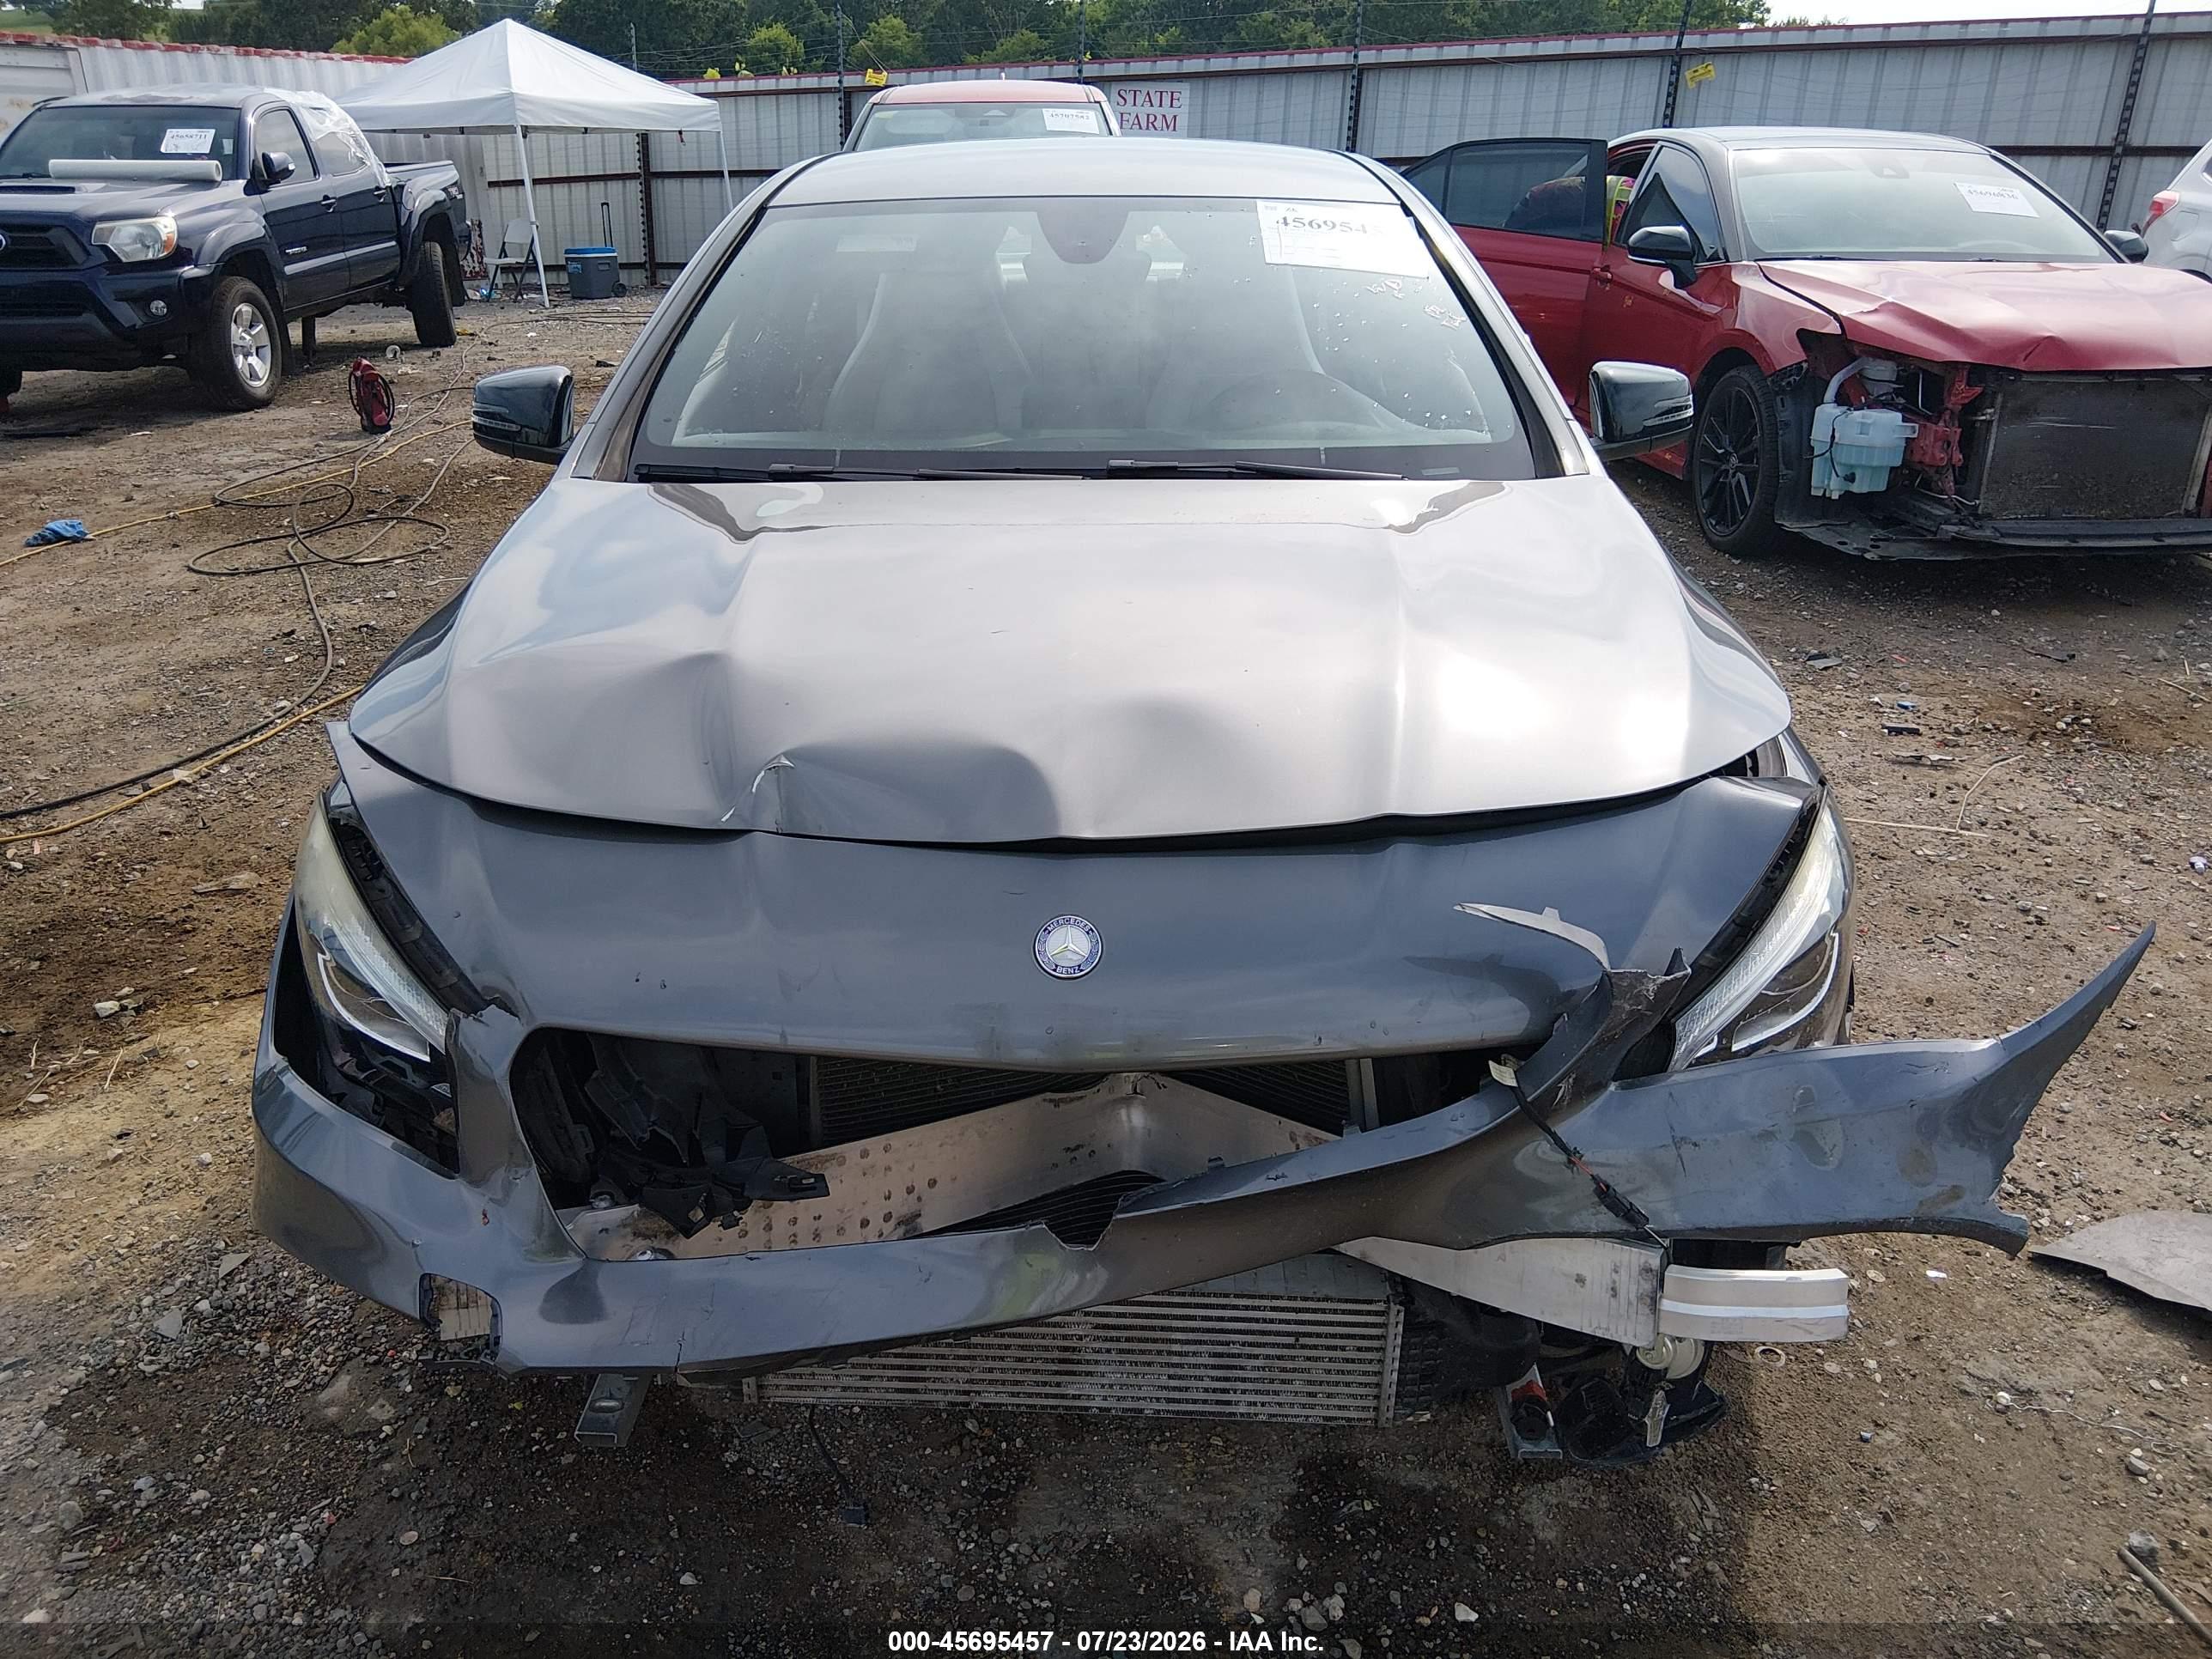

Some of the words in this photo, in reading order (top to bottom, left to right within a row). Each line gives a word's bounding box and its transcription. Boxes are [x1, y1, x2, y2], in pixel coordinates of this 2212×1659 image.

[1116, 88, 1182, 109] STATE
[1119, 112, 1178, 132] FARM
[1047, 917, 1091, 933] MERCEDES
